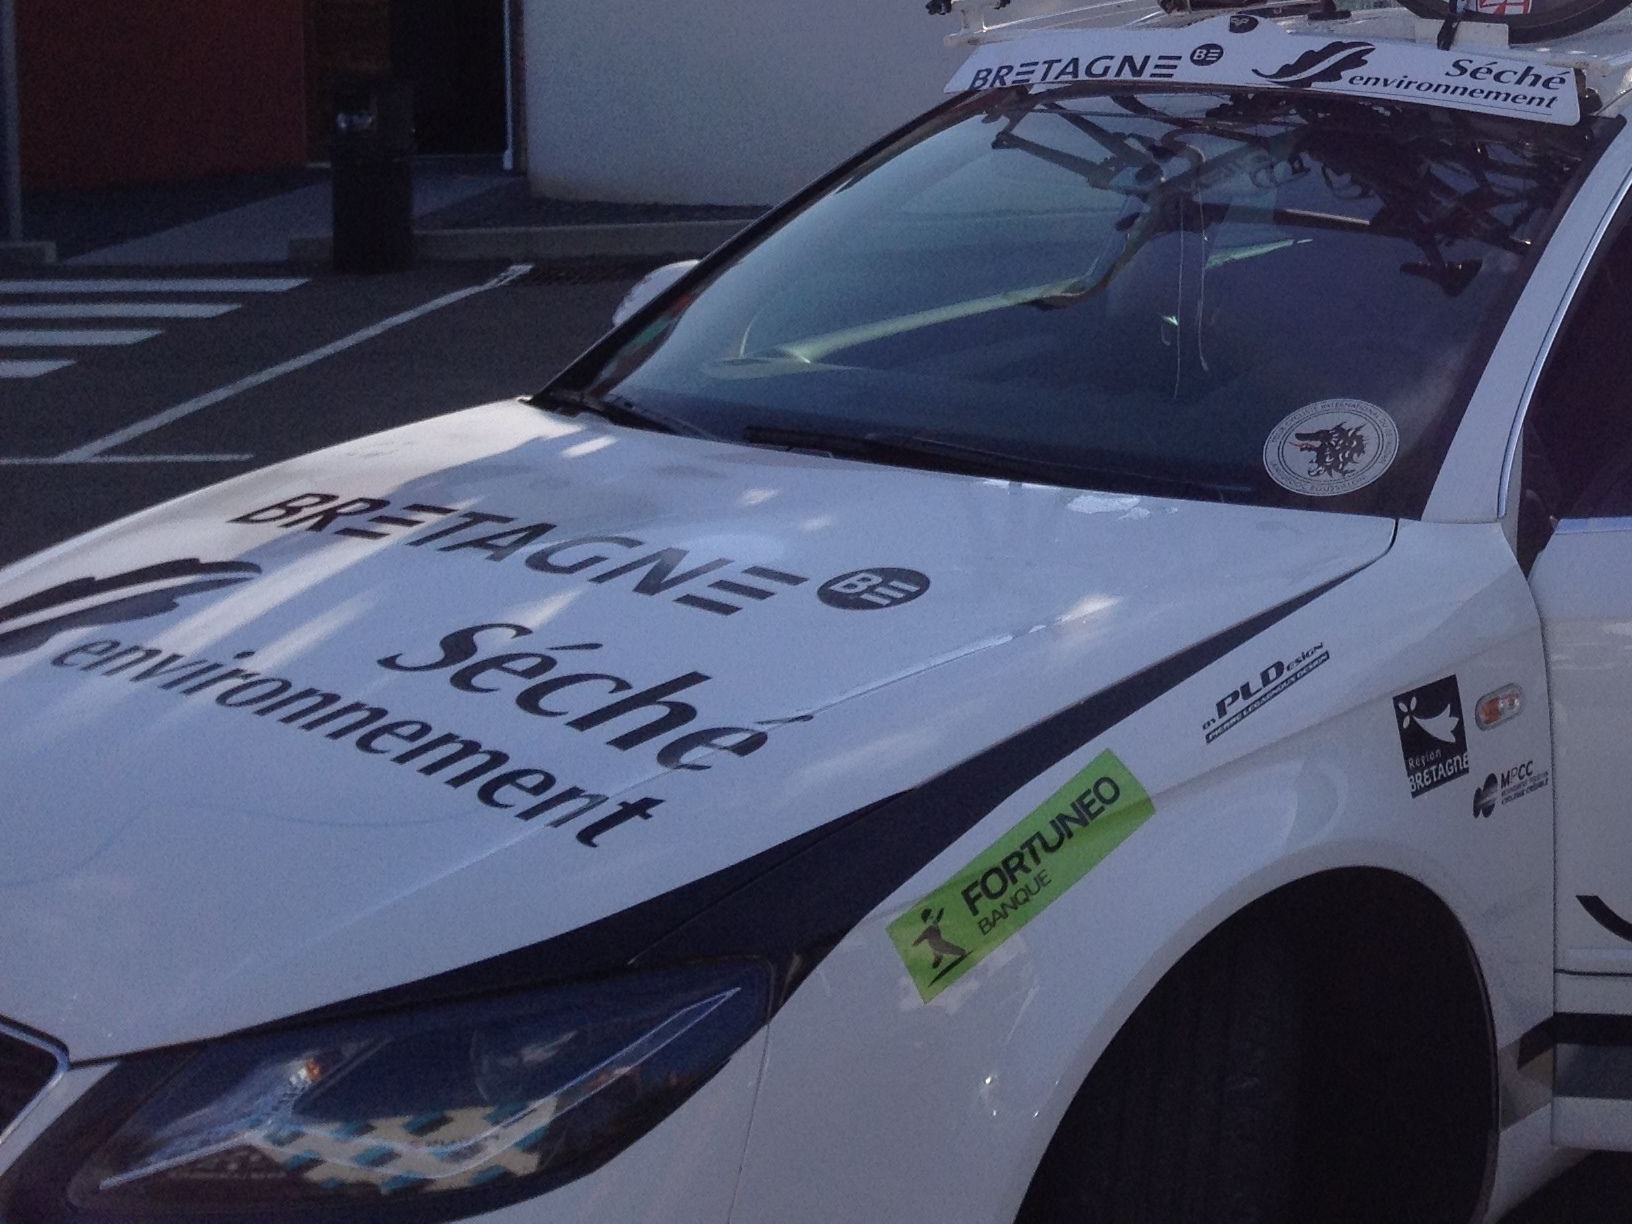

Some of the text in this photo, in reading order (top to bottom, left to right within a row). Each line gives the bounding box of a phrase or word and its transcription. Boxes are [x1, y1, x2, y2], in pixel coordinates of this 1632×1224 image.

[969, 54, 1183, 90] BRETAGNE
[1348, 74, 1559, 109] environnement
[1445, 58, 1571, 91] Séché
[227, 492, 809, 616] BRETAGNE
[377, 622, 814, 772] Séché
[51, 639, 666, 848] environnement
[1409, 751, 1469, 793] BRETAGNE
[961, 776, 1121, 917] FORTUNEO
[977, 868, 1053, 936] BANQUE
